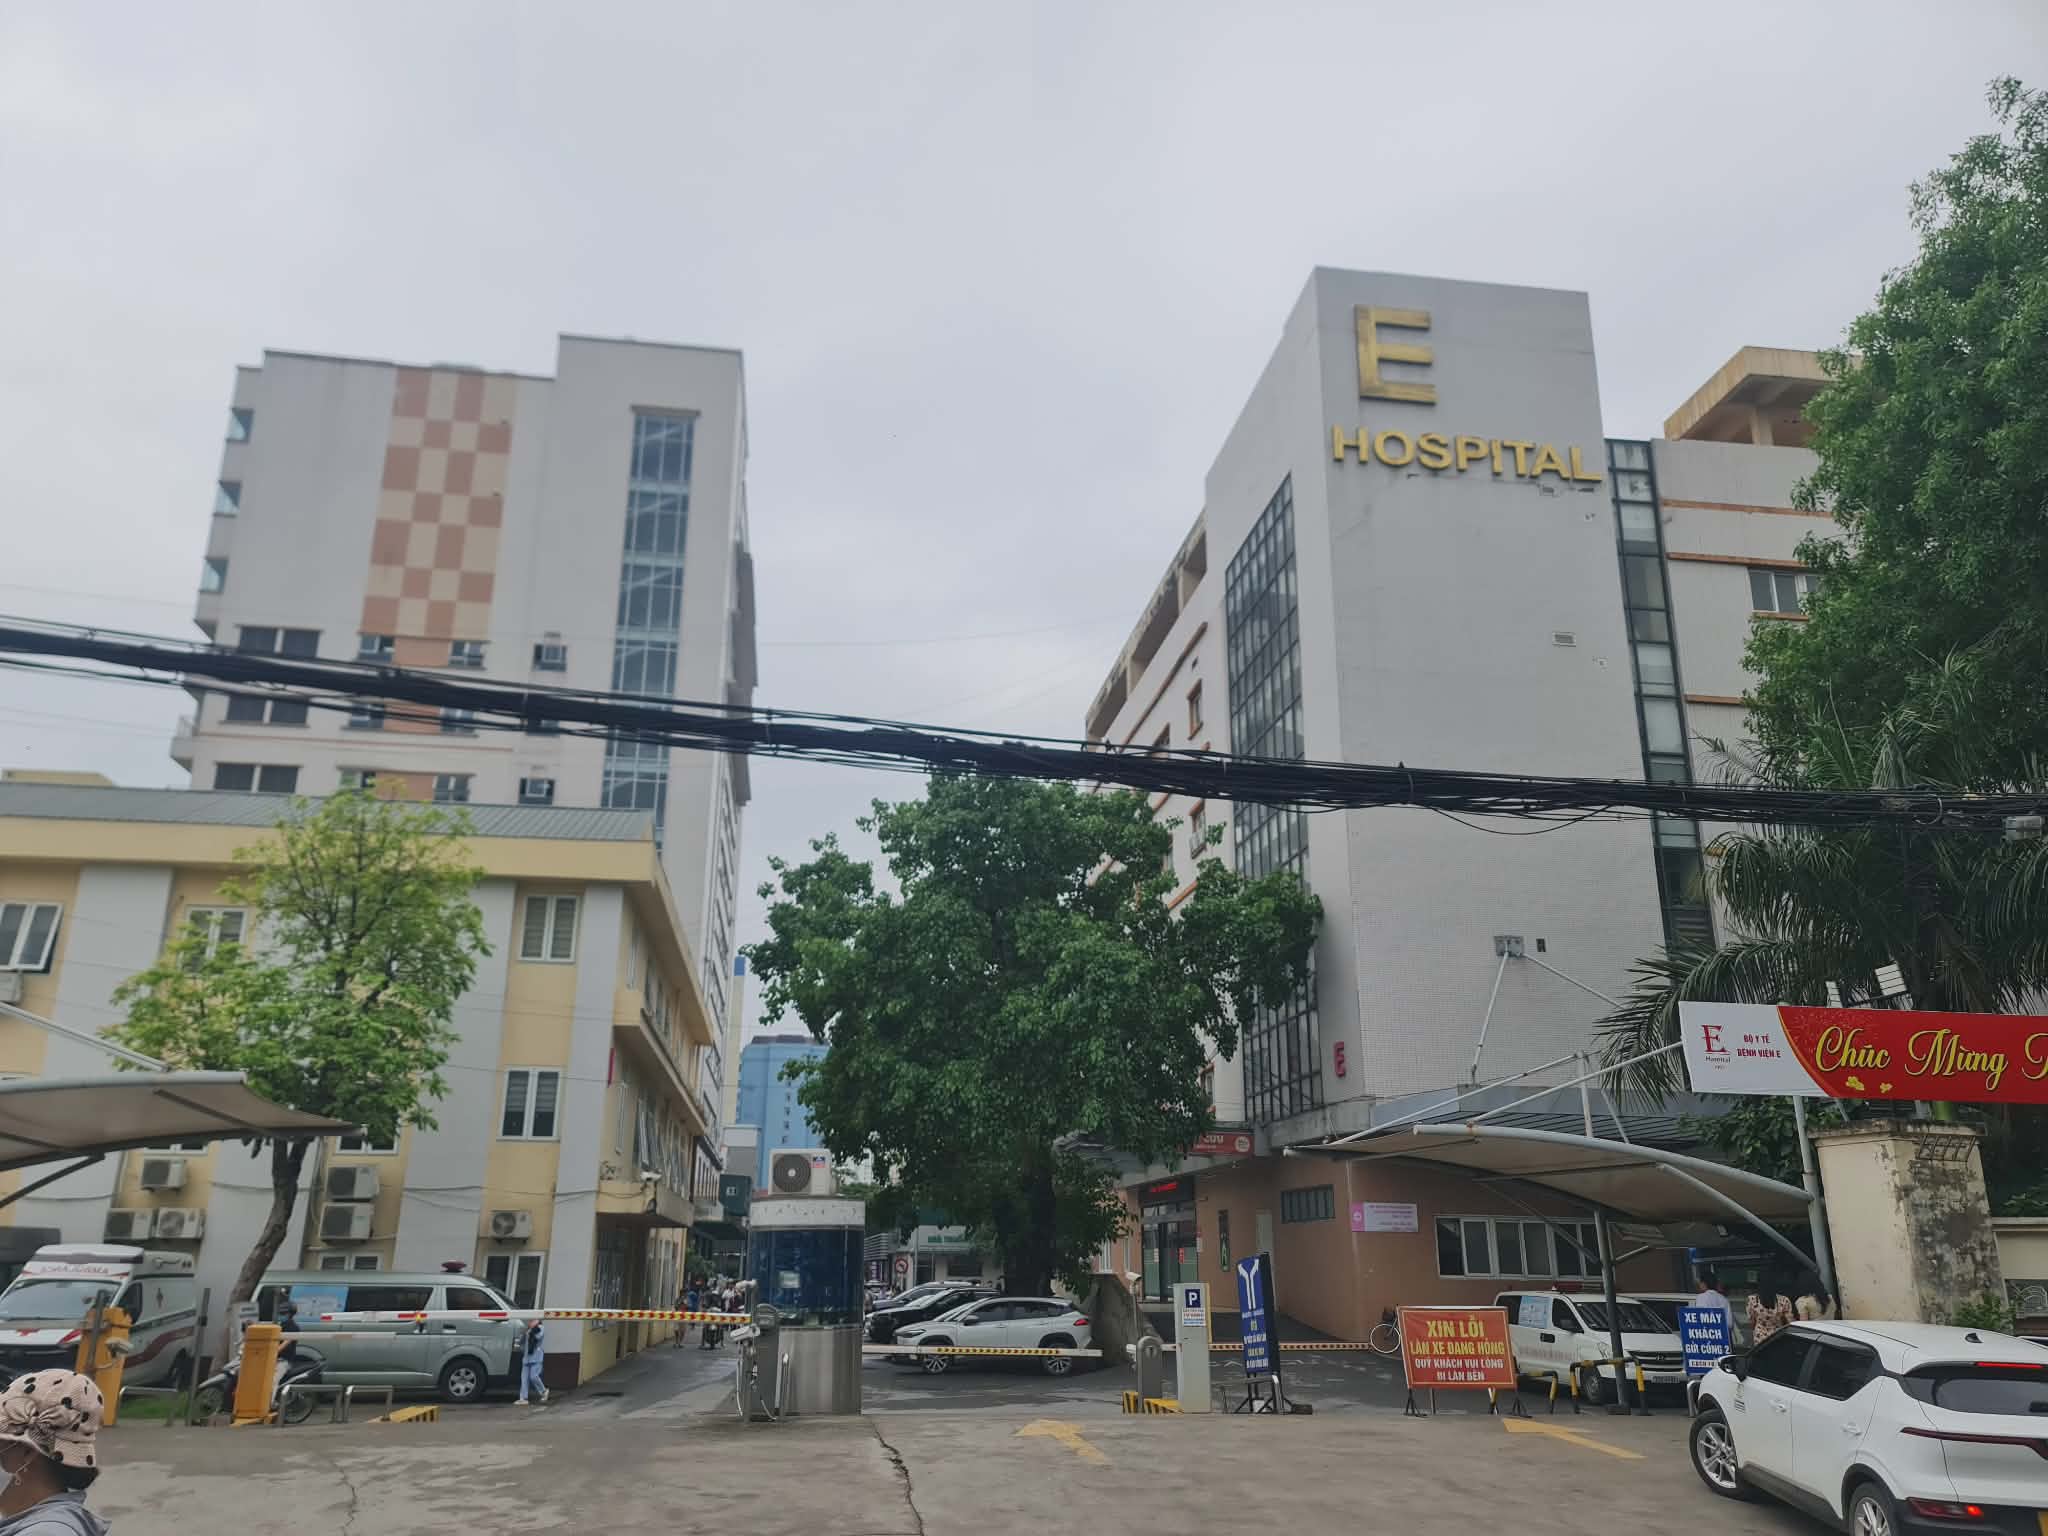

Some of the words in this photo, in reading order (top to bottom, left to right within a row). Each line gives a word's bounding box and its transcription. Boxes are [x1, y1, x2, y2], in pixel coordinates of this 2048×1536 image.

[1354, 304, 1438, 406] E
[1332, 424, 1603, 482] HOSPITAL
[1815, 1026, 1892, 1072] Chúc
[1904, 1029, 2009, 1092] Mừng
[1188, 1292, 1198, 1306] P
[1684, 1312, 1697, 1324] XE
[1427, 1320, 1455, 1338] XIN
[1688, 1327, 1723, 1340] KHÁCH
[1432, 1341, 1446, 1355] XE
[1434, 1357, 1462, 1369] KHÁCH
[1463, 1358, 1479, 1369] VUI
